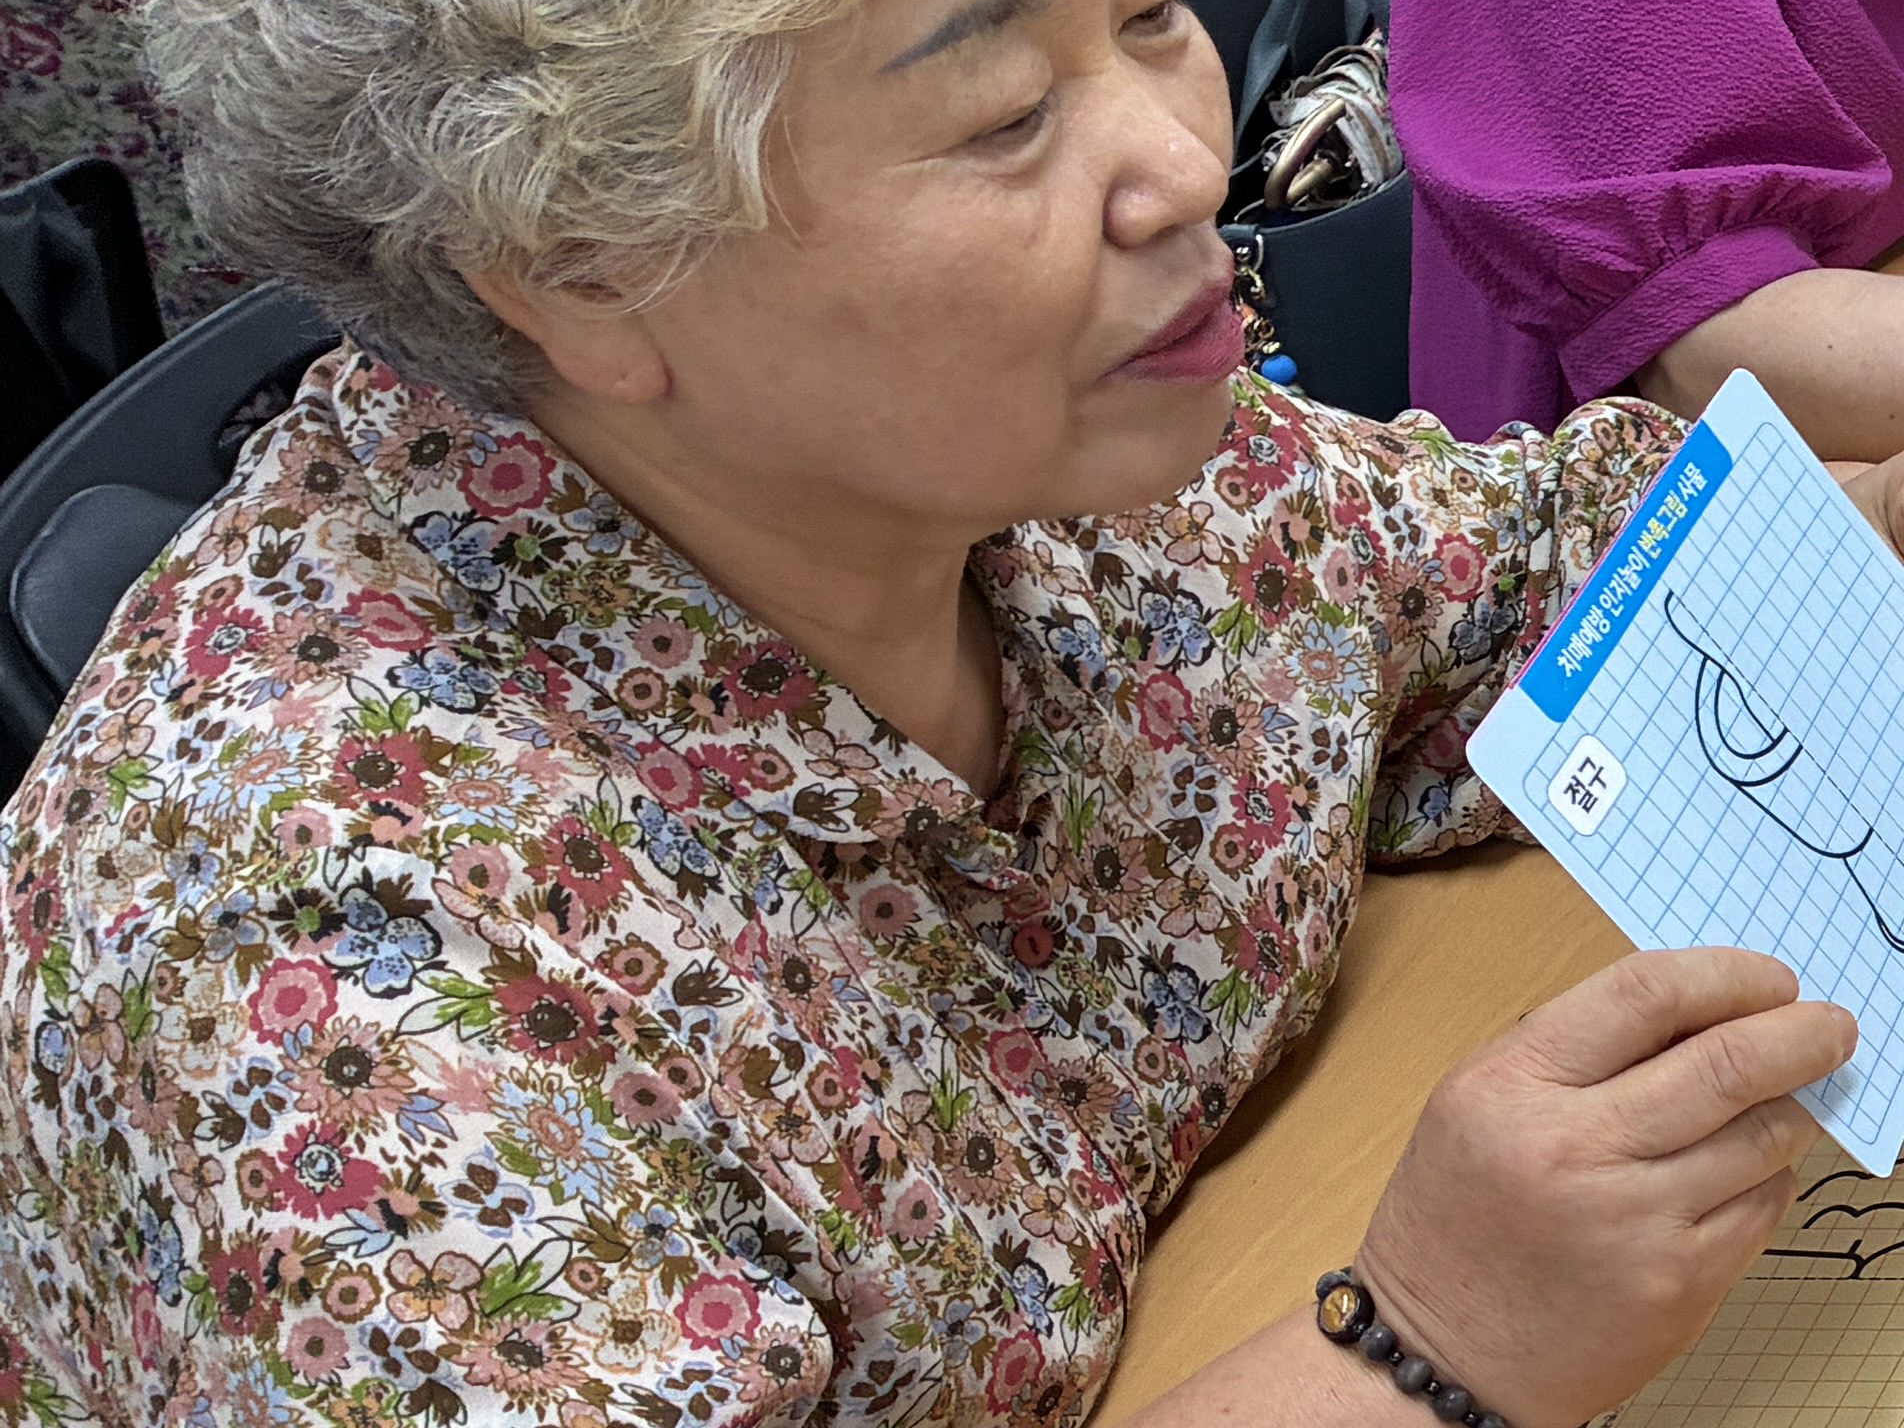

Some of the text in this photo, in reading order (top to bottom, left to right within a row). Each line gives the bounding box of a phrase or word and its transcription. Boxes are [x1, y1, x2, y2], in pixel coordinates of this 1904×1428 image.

[1557, 461, 1708, 678] 치매예방 인지놀이 반쪽그림 사물
[1562, 755, 1608, 815] 절구
